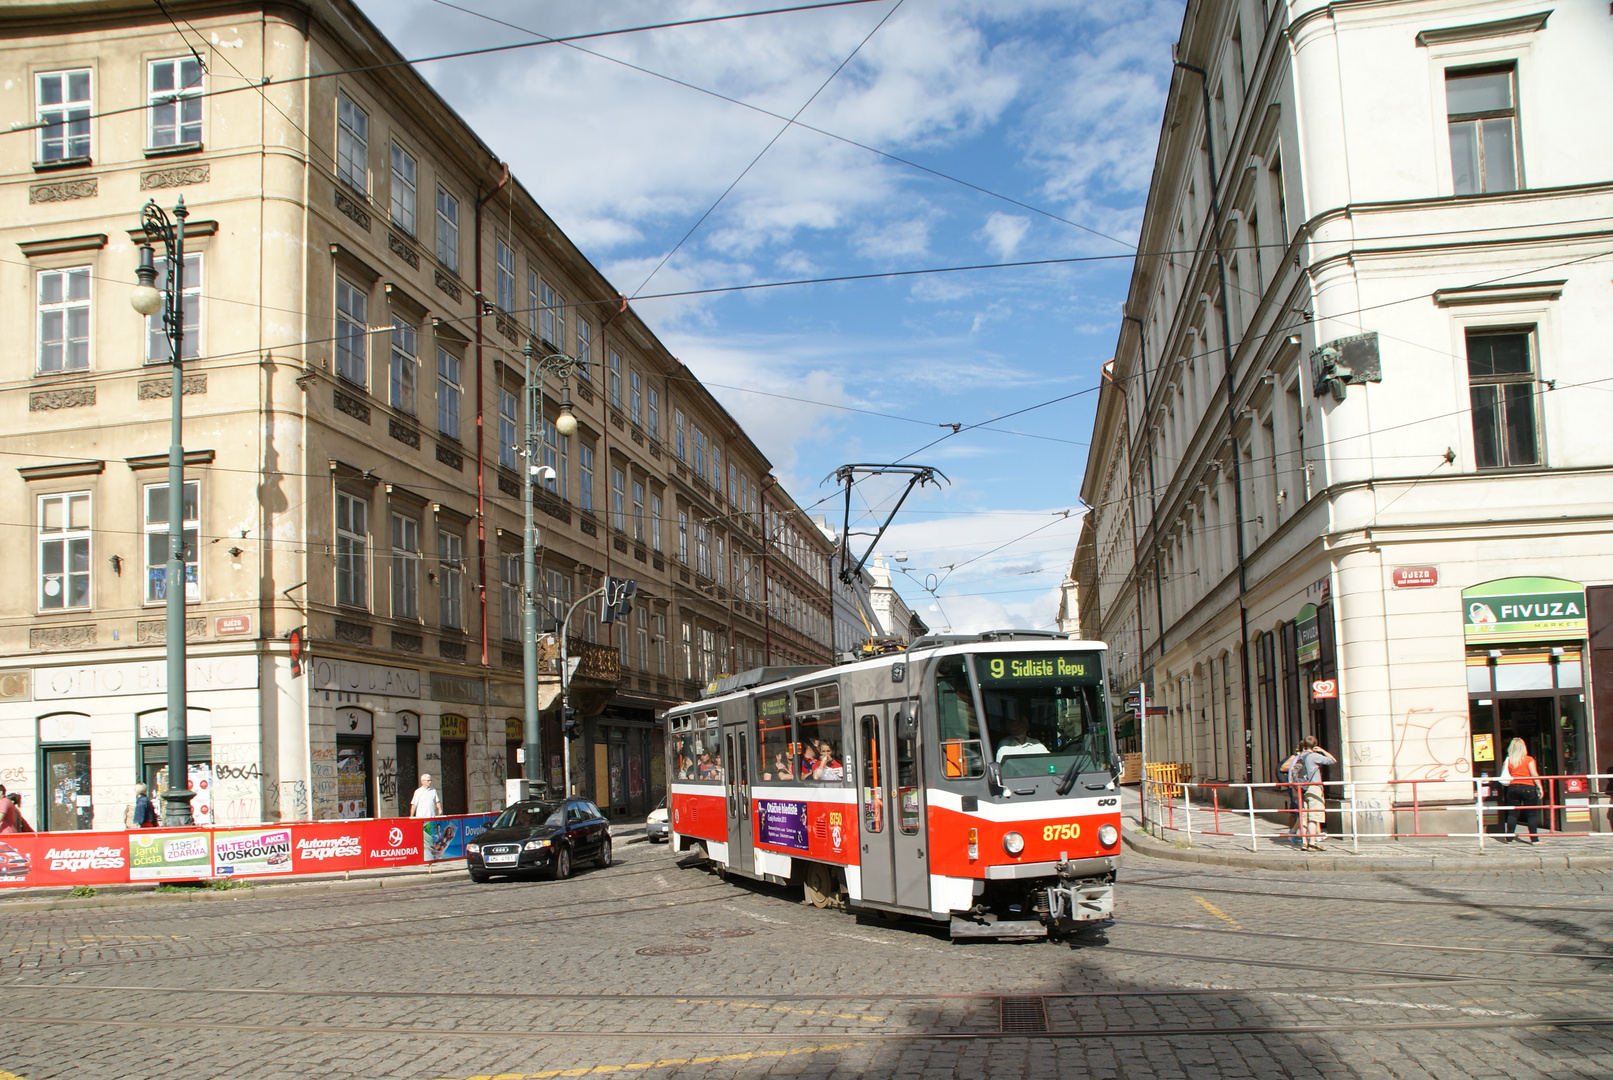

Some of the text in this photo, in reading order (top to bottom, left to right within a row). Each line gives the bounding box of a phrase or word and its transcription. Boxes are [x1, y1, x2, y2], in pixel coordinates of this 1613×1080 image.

[1401, 570, 1430, 579] ÚJEZD
[1501, 602, 1580, 619] FIVUZA
[139, 661, 238, 689] BLNC
[318, 661, 361, 688] OTTO
[990, 656, 1084, 679] 9 Sídliště Řepy
[440, 679, 480, 700] MUSIC
[829, 812, 842, 826] 8750
[1043, 823, 1080, 841] 8750
[216, 834, 285, 852] HI-TECH AKCE
[296, 835, 359, 849] Automyčka
[44, 846, 122, 860] Automyčka
[135, 844, 158, 856] Jarní
[168, 848, 206, 858] ZDARMA
[300, 845, 362, 860] Express
[370, 847, 418, 858] ALEXANDRIA
[50, 857, 125, 872] Express
[133, 855, 162, 865] očista
